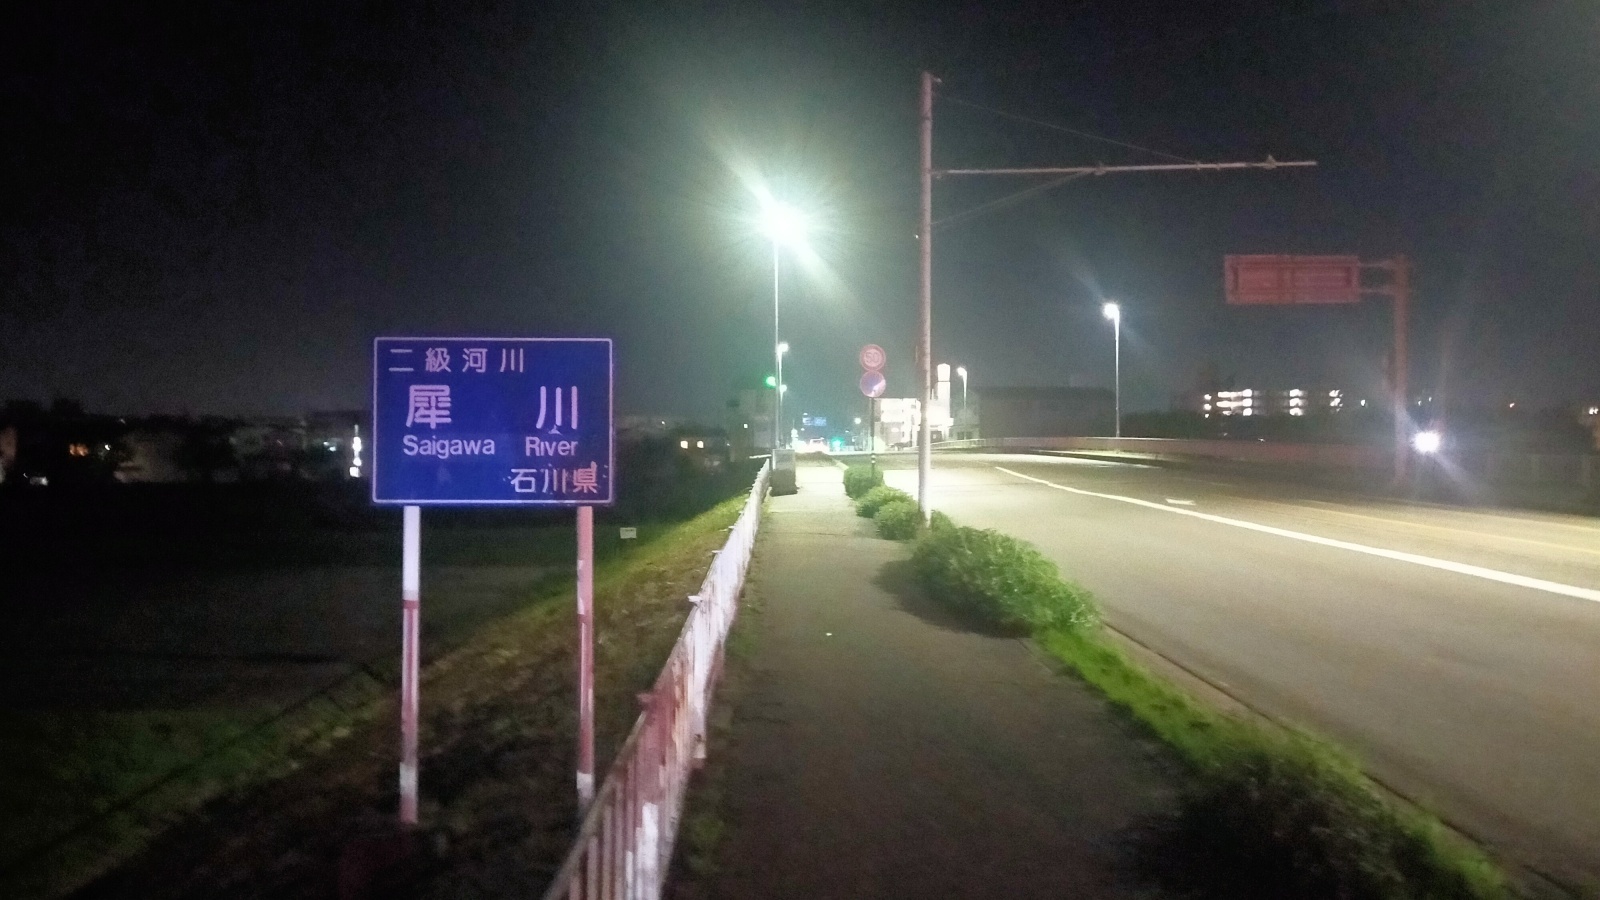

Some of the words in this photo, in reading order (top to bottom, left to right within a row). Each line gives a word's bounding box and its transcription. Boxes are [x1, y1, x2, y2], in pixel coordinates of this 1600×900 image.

[389, 347, 524, 373] 二級河川
[403, 435, 495, 459] Saigawa
[525, 436, 578, 457] River
[511, 466, 598, 493] 石川県
